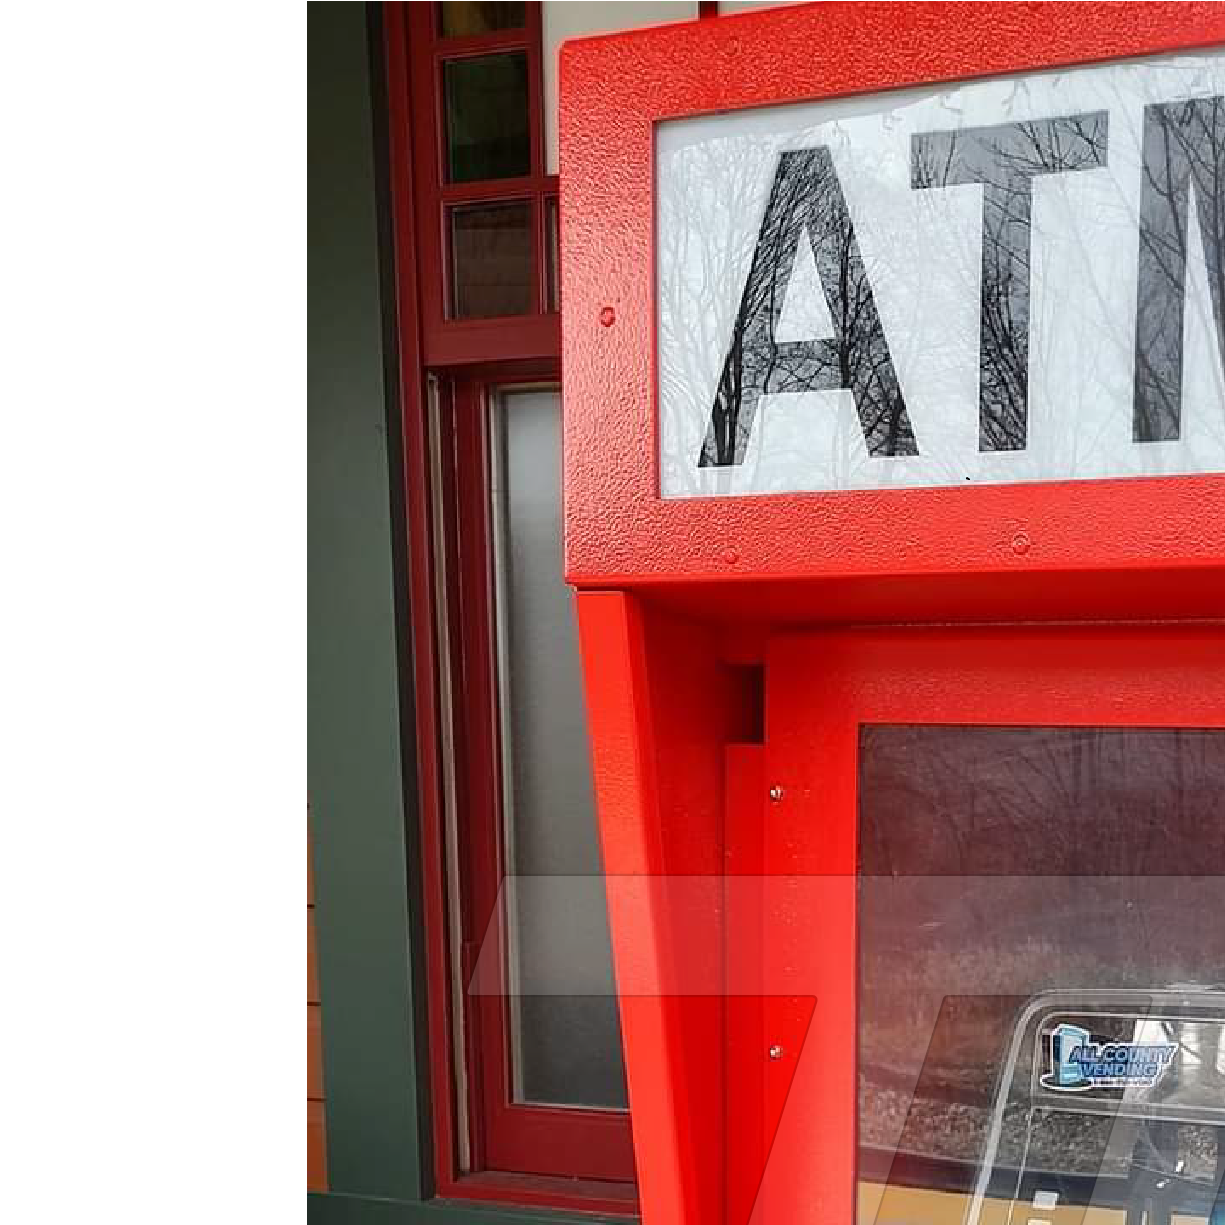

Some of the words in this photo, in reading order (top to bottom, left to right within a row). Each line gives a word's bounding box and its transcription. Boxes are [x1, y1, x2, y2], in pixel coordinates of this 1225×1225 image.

[1068, 1045, 1098, 1063] ALL
[1100, 1045, 1176, 1063] COUNTY
[1080, 1062, 1158, 1077] VENDING
